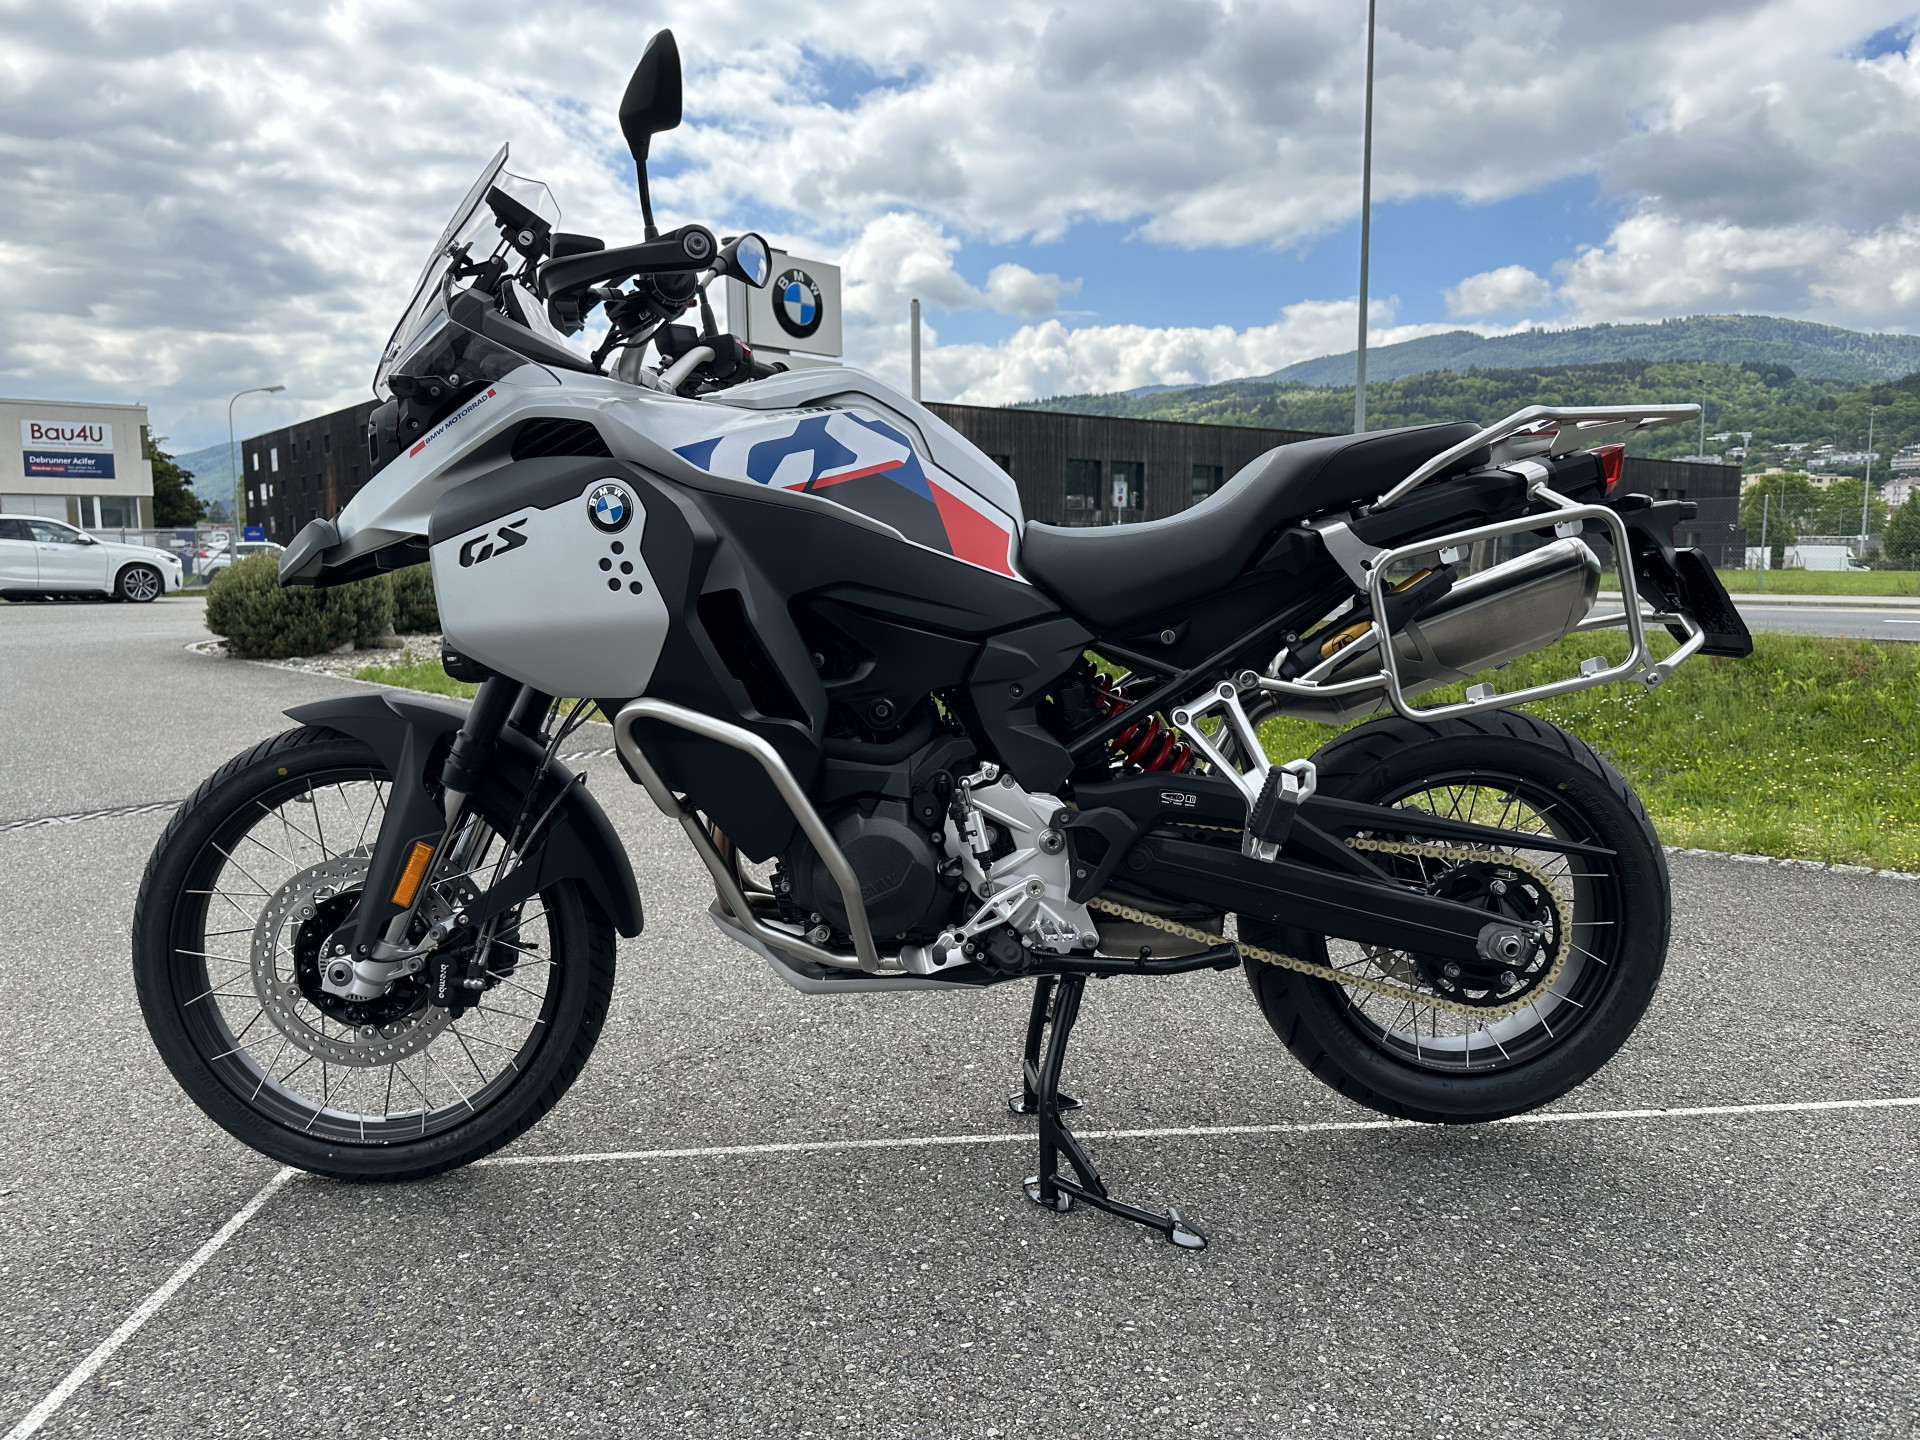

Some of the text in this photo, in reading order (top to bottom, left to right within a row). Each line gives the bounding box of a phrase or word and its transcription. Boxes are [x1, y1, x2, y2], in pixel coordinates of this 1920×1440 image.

[777, 270, 820, 296] BMW
[30, 422, 104, 442] Bau4U
[425, 394, 489, 445] BMW MOTORRAD
[29, 456, 96, 466] Debrunner Acifer
[588, 487, 624, 507] BMW
[459, 517, 529, 568] GS
[438, 963, 450, 999] brembo
